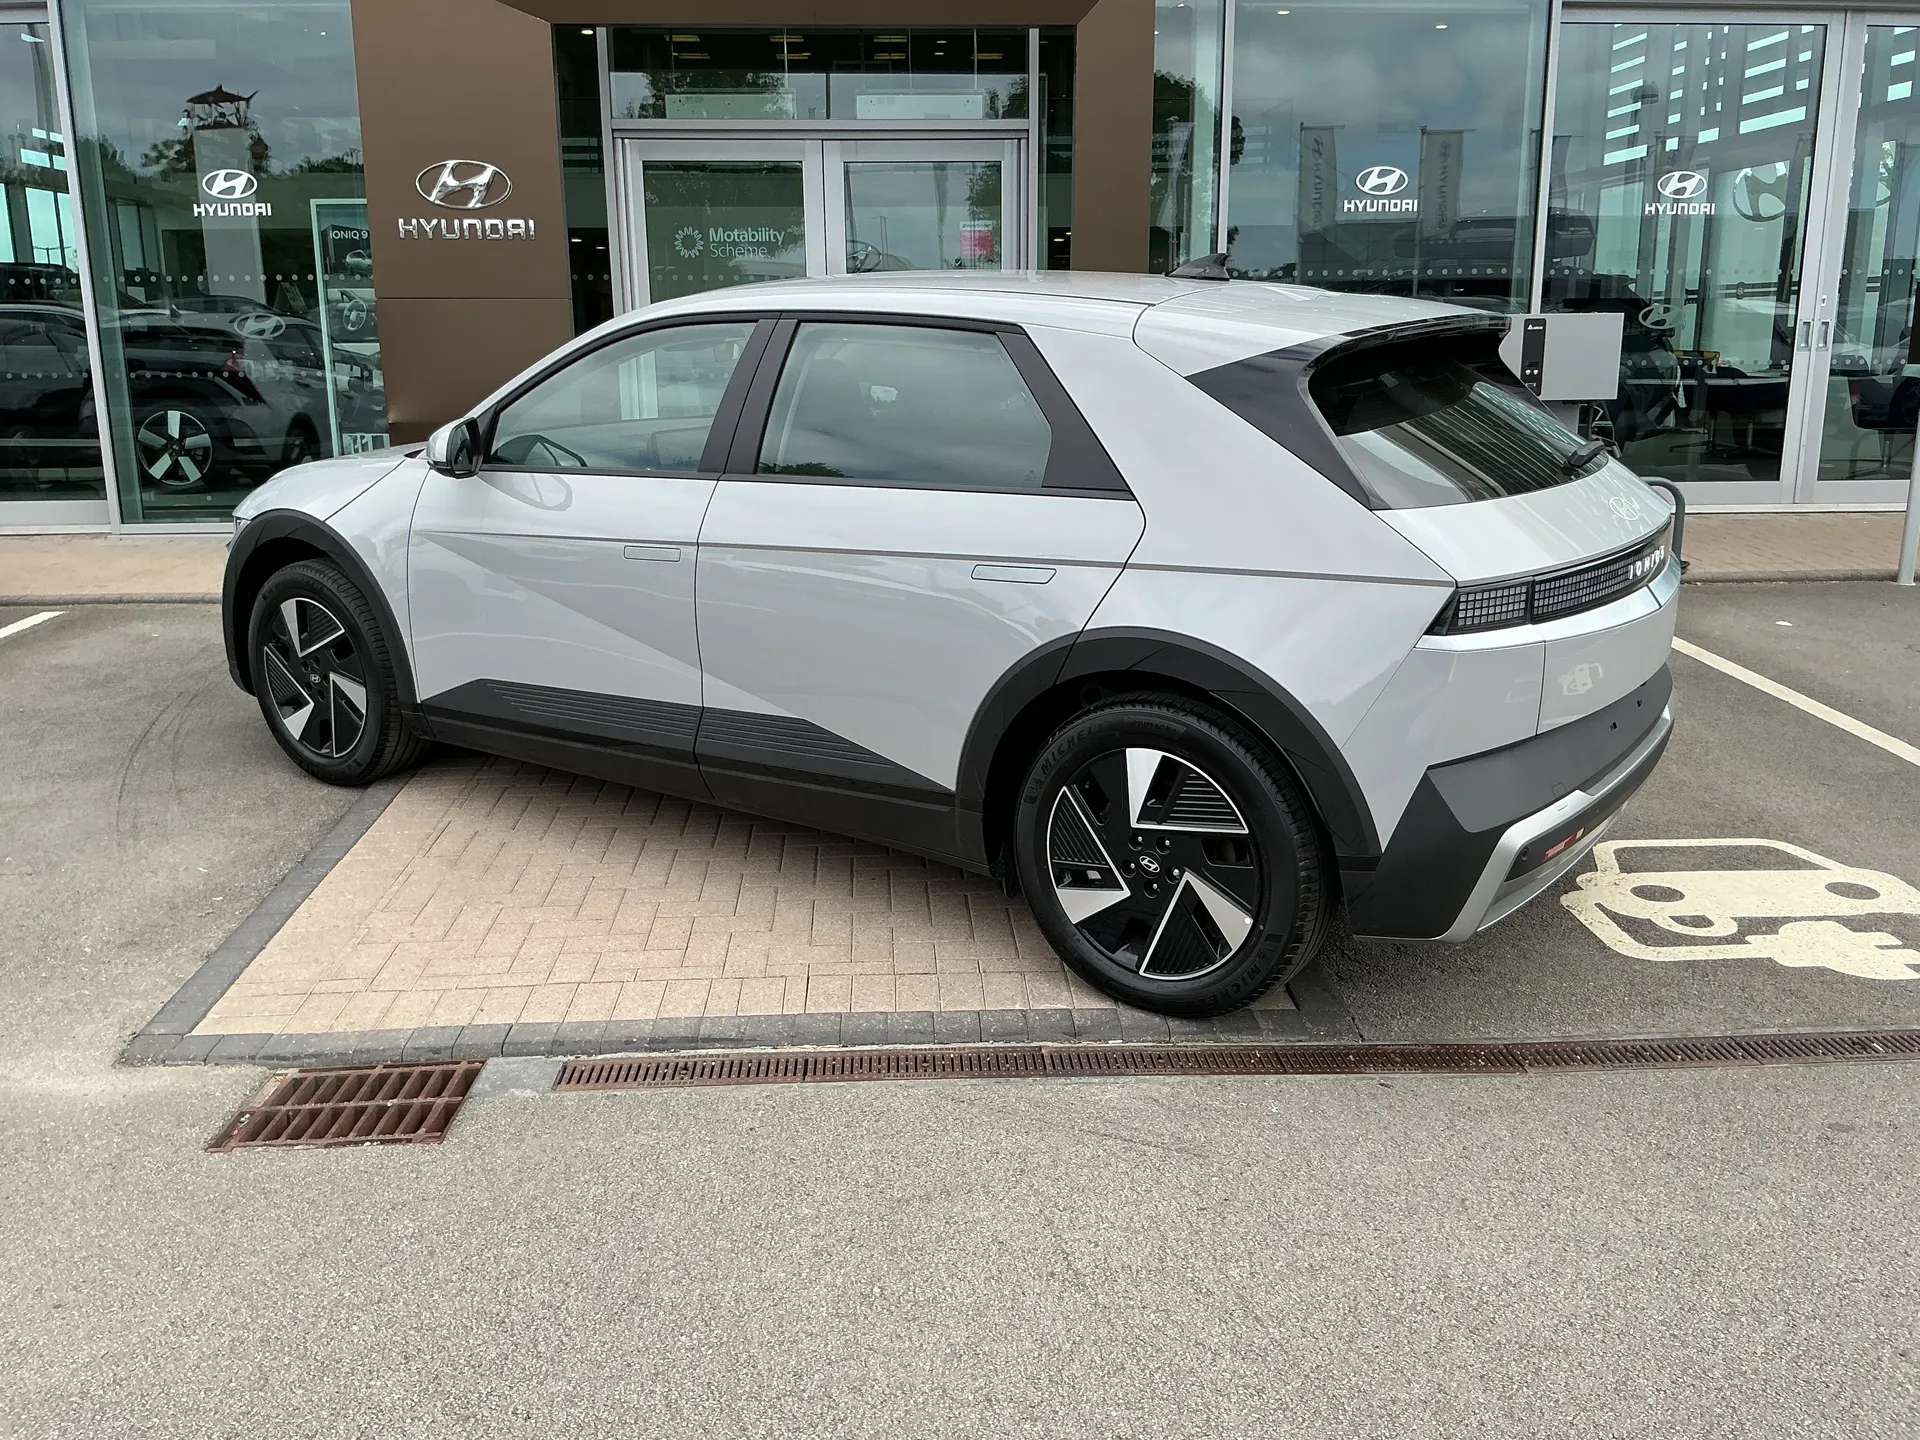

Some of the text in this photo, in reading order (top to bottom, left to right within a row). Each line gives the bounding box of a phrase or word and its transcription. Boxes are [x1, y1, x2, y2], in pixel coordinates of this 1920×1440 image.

[193, 203, 272, 217] HYUNDAI
[1343, 199, 1418, 213] HYUNDAI
[1644, 203, 1716, 215] HYUNDAI
[329, 230, 368, 240] IONIQ 9
[398, 218, 536, 240] HYUNDAI
[709, 227, 785, 246] Motability
[710, 243, 768, 258] Scheme
